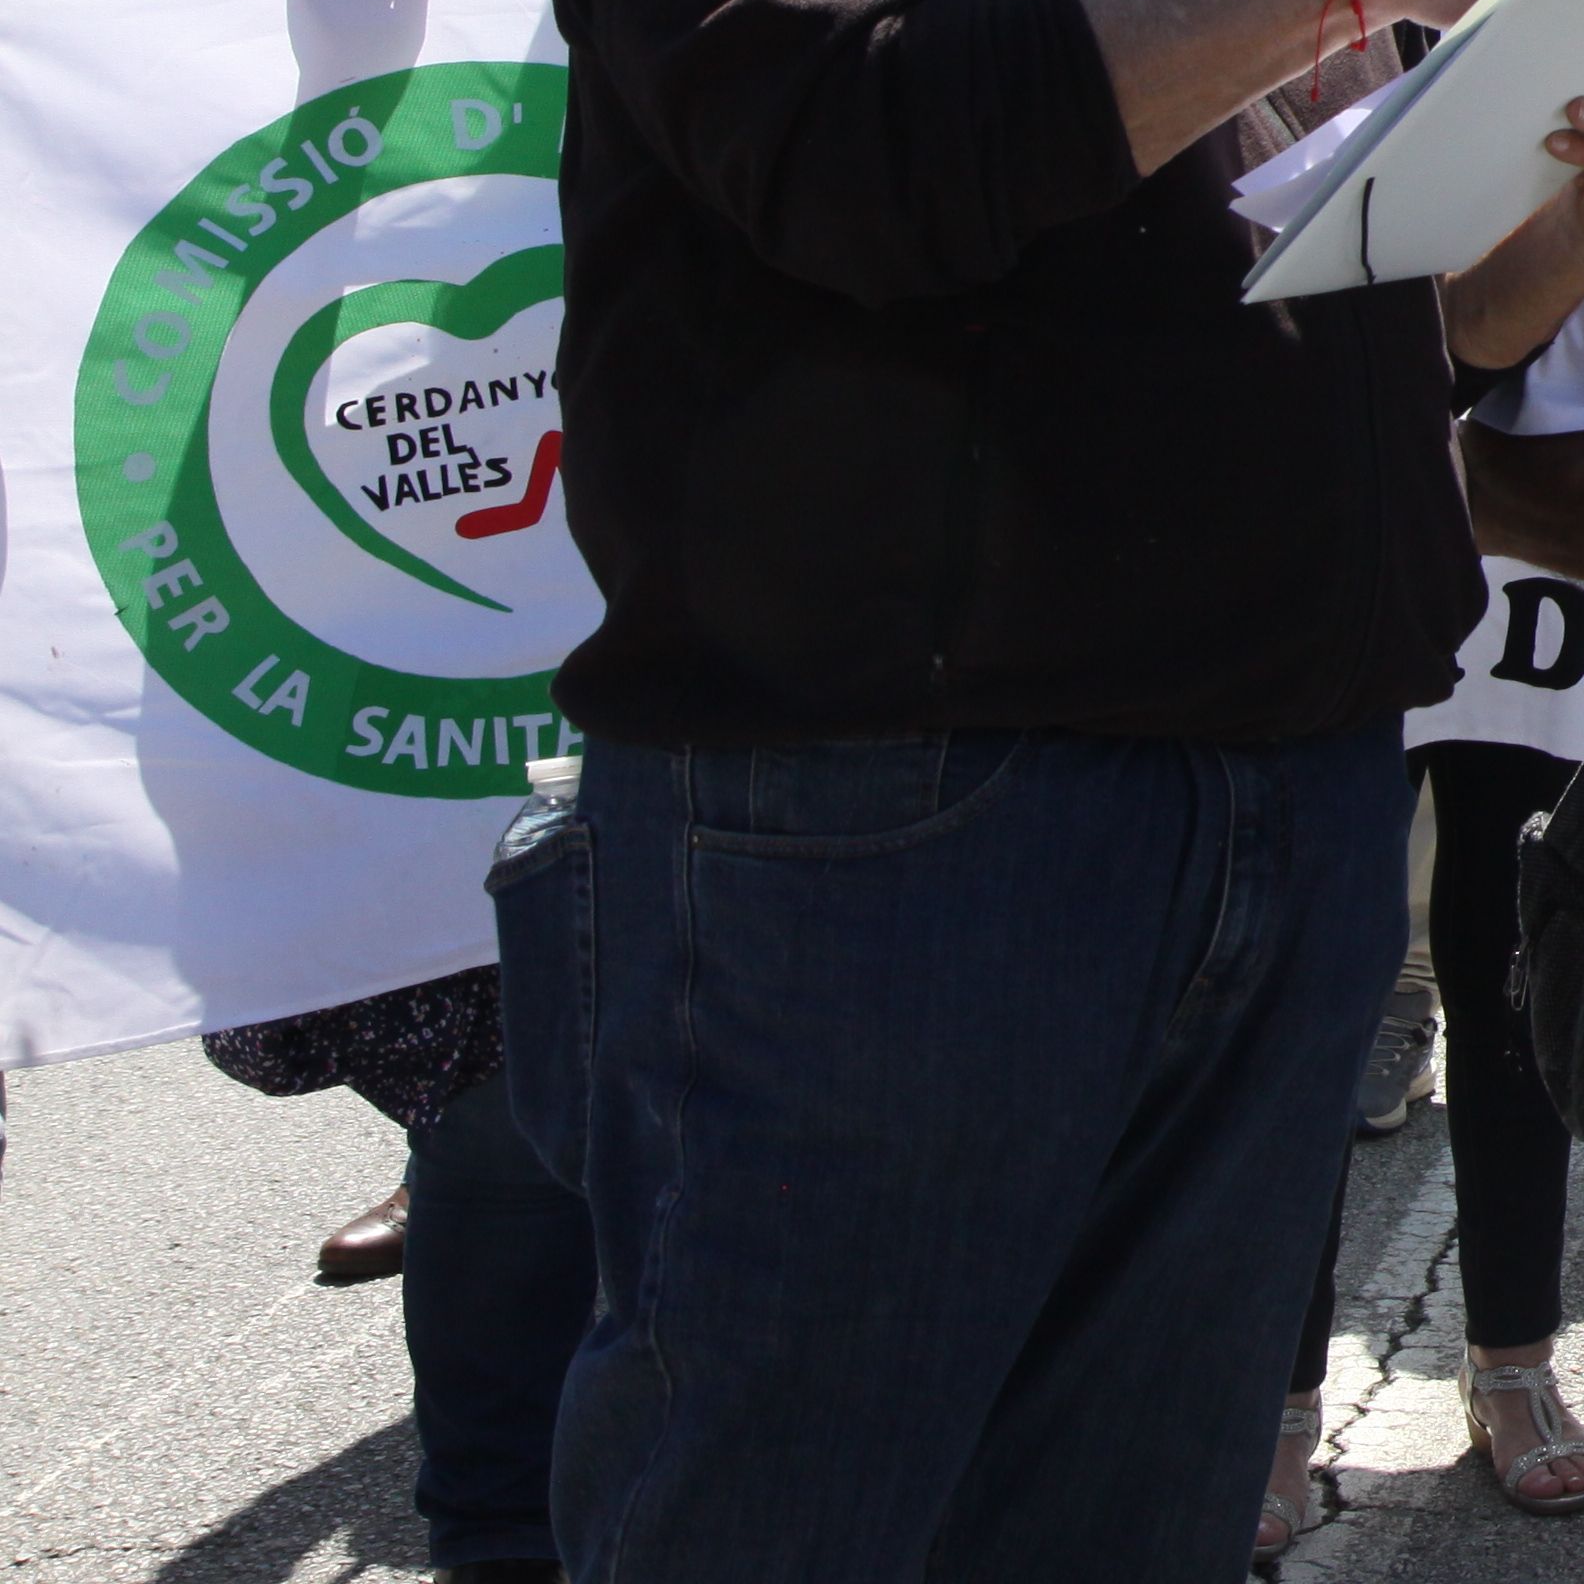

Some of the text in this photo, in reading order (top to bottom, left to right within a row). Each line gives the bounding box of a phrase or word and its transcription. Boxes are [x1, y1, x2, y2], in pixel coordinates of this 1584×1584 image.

[115, 103, 386, 406] COMISSIÓ
[336, 370, 560, 430] CERDANY
[361, 447, 513, 512] VALLÈS
[386, 424, 468, 466] DEL
[117, 520, 231, 652] PER
[231, 654, 311, 728] LA
